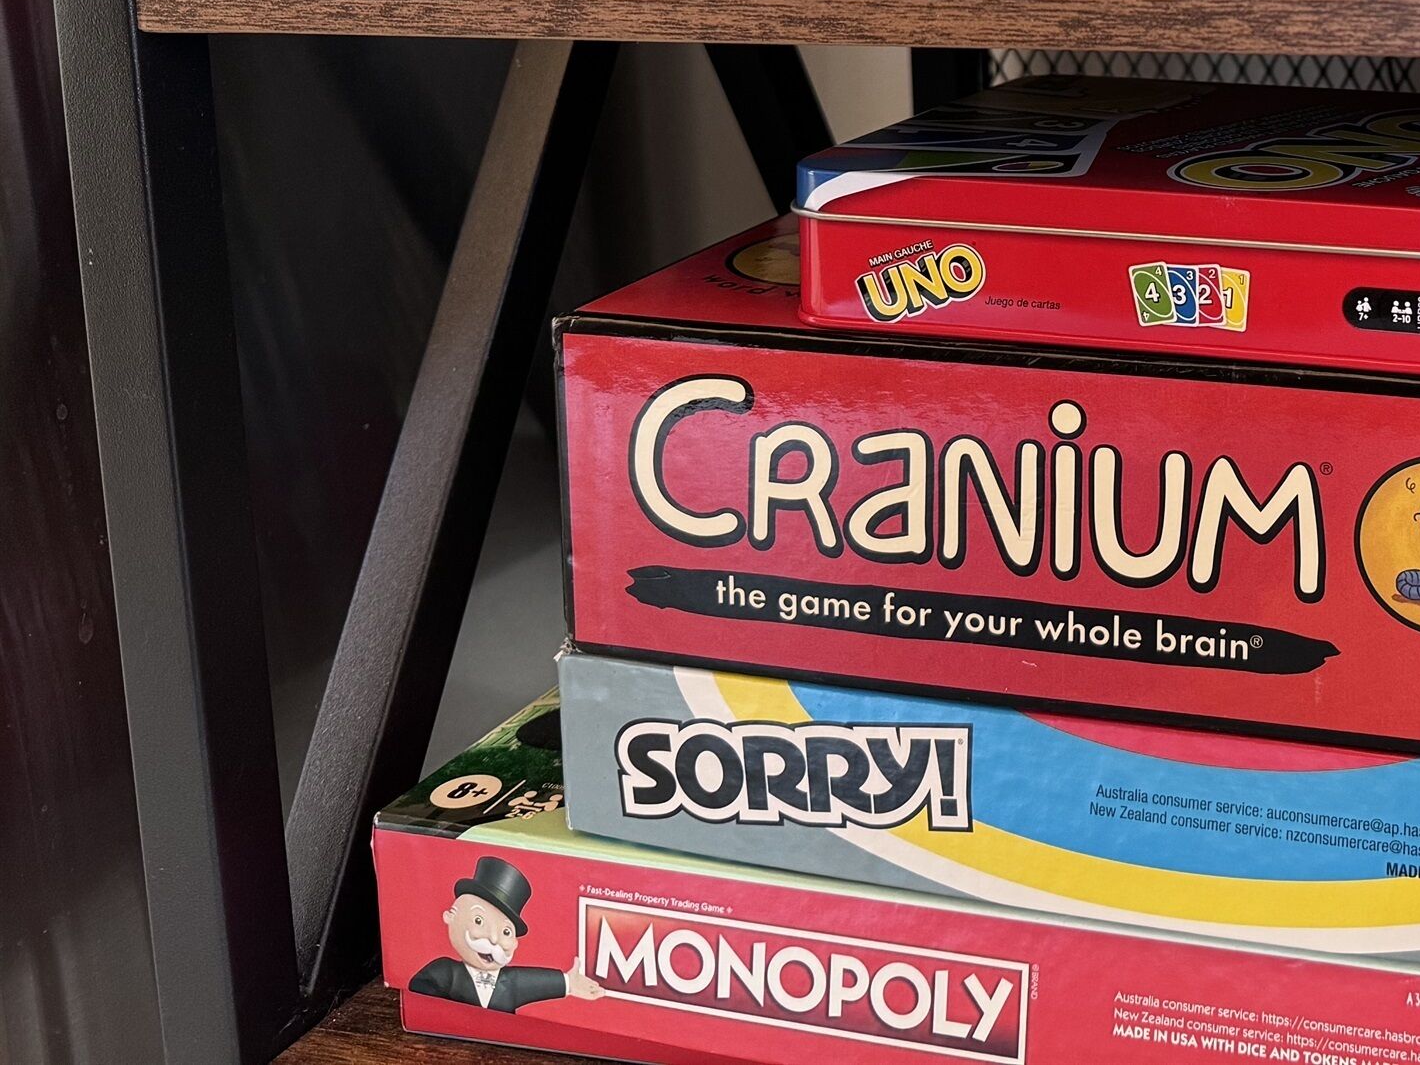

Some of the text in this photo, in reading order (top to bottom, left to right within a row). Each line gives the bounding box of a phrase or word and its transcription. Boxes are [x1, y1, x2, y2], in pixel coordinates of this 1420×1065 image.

[868, 240, 934, 268] MAIN GAUCHE
[859, 244, 985, 320] UNO
[1155, 266, 1162, 276] 4
[1186, 270, 1194, 280] 3
[1208, 269, 1216, 279] 2
[984, 295, 1061, 310] Juego de cartas
[1145, 282, 1161, 303] 4
[1172, 284, 1187, 305] 3
[1198, 283, 1214, 305] 2
[1222, 287, 1233, 309] 1
[1358, 312, 1369, 321] 7+
[1392, 313, 1411, 324] 2-10
[715, 578, 766, 610] the
[778, 594, 872, 623] game
[882, 595, 931, 628] for
[944, 612, 1023, 639] your
[1035, 610, 1142, 650] whole
[620, 722, 966, 825] SORRY!
[446, 781, 489, 800] 8+
[1095, 783, 1149, 804] Australia
[1152, 790, 1213, 812] consumer
[1215, 797, 1264, 819] service:
[504, 808, 537, 820] 2-6
[1089, 801, 1116, 819] New
[1119, 804, 1168, 826] Zealand
[1171, 811, 1231, 834] consumer
[1234, 819, 1284, 840] service:
[586, 885, 725, 914] Fast-Dealing Property Trading Game
[594, 915, 1014, 1043] MONOPOLY
[1114, 990, 1160, 1008] Australia
[1162, 998, 1216, 1016] consumer
[1218, 1007, 1259, 1022] service:
[1113, 1007, 1139, 1021] New
[1141, 1011, 1184, 1028] Zealand
[1186, 1019, 1240, 1036] consumer
[1242, 1028, 1284, 1043] service:
[1113, 1023, 1151, 1040] MADE
[1153, 1030, 1168, 1043] IN
[1171, 1032, 1198, 1048] USA
[1201, 1036, 1235, 1053] WITH
[1238, 1042, 1267, 1057] DICE
[1269, 1047, 1300, 1063] AND
